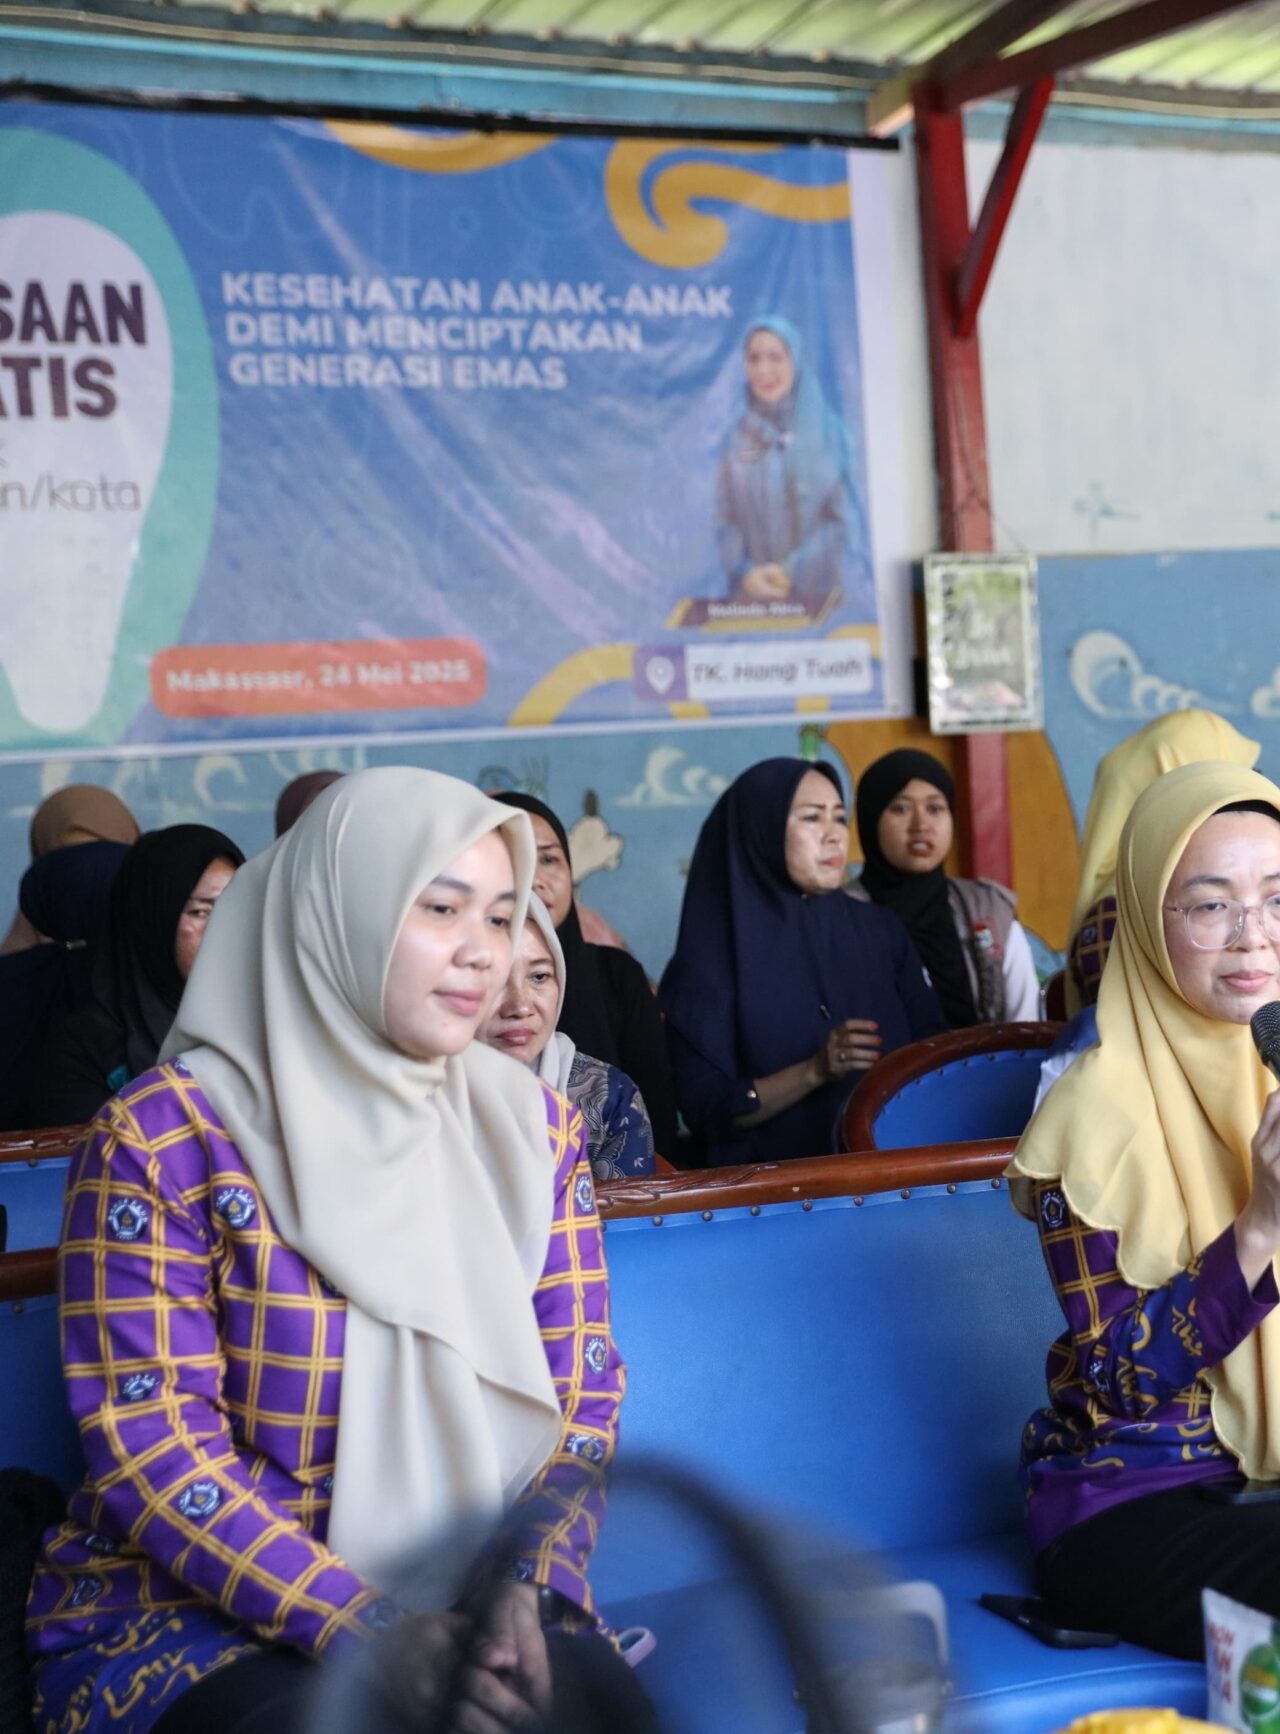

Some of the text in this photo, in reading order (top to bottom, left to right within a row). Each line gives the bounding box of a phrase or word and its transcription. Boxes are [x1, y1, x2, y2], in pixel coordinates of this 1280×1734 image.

[222, 271, 735, 318] KESEHATAN ANAK-ANAK
[225, 311, 643, 351] DEMI MENCIPTAKAN
[0, 355, 117, 419] TIS
[228, 352, 568, 390] GENERASI EMAS
